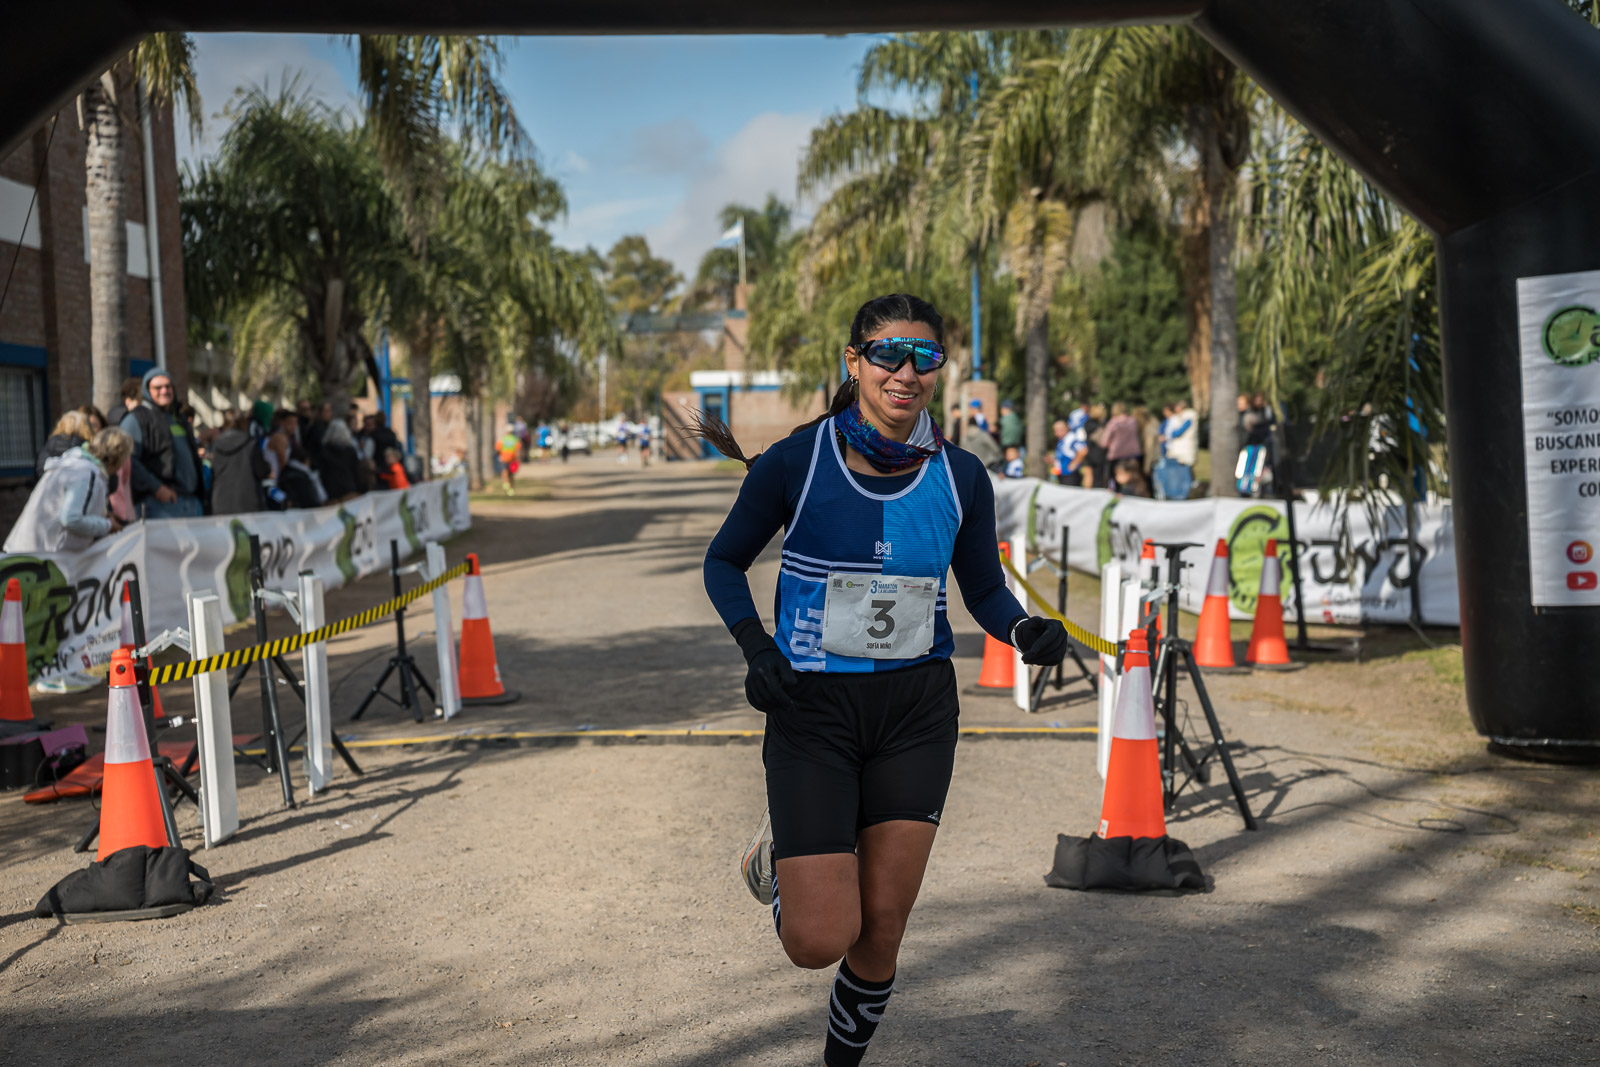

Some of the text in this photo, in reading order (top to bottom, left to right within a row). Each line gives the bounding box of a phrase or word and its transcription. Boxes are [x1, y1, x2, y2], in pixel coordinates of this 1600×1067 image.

[1547, 408, 1600, 426] “SOMO
[1579, 481, 1600, 498] CO
[870, 580, 878, 594] 3
[867, 600, 897, 639] 3
